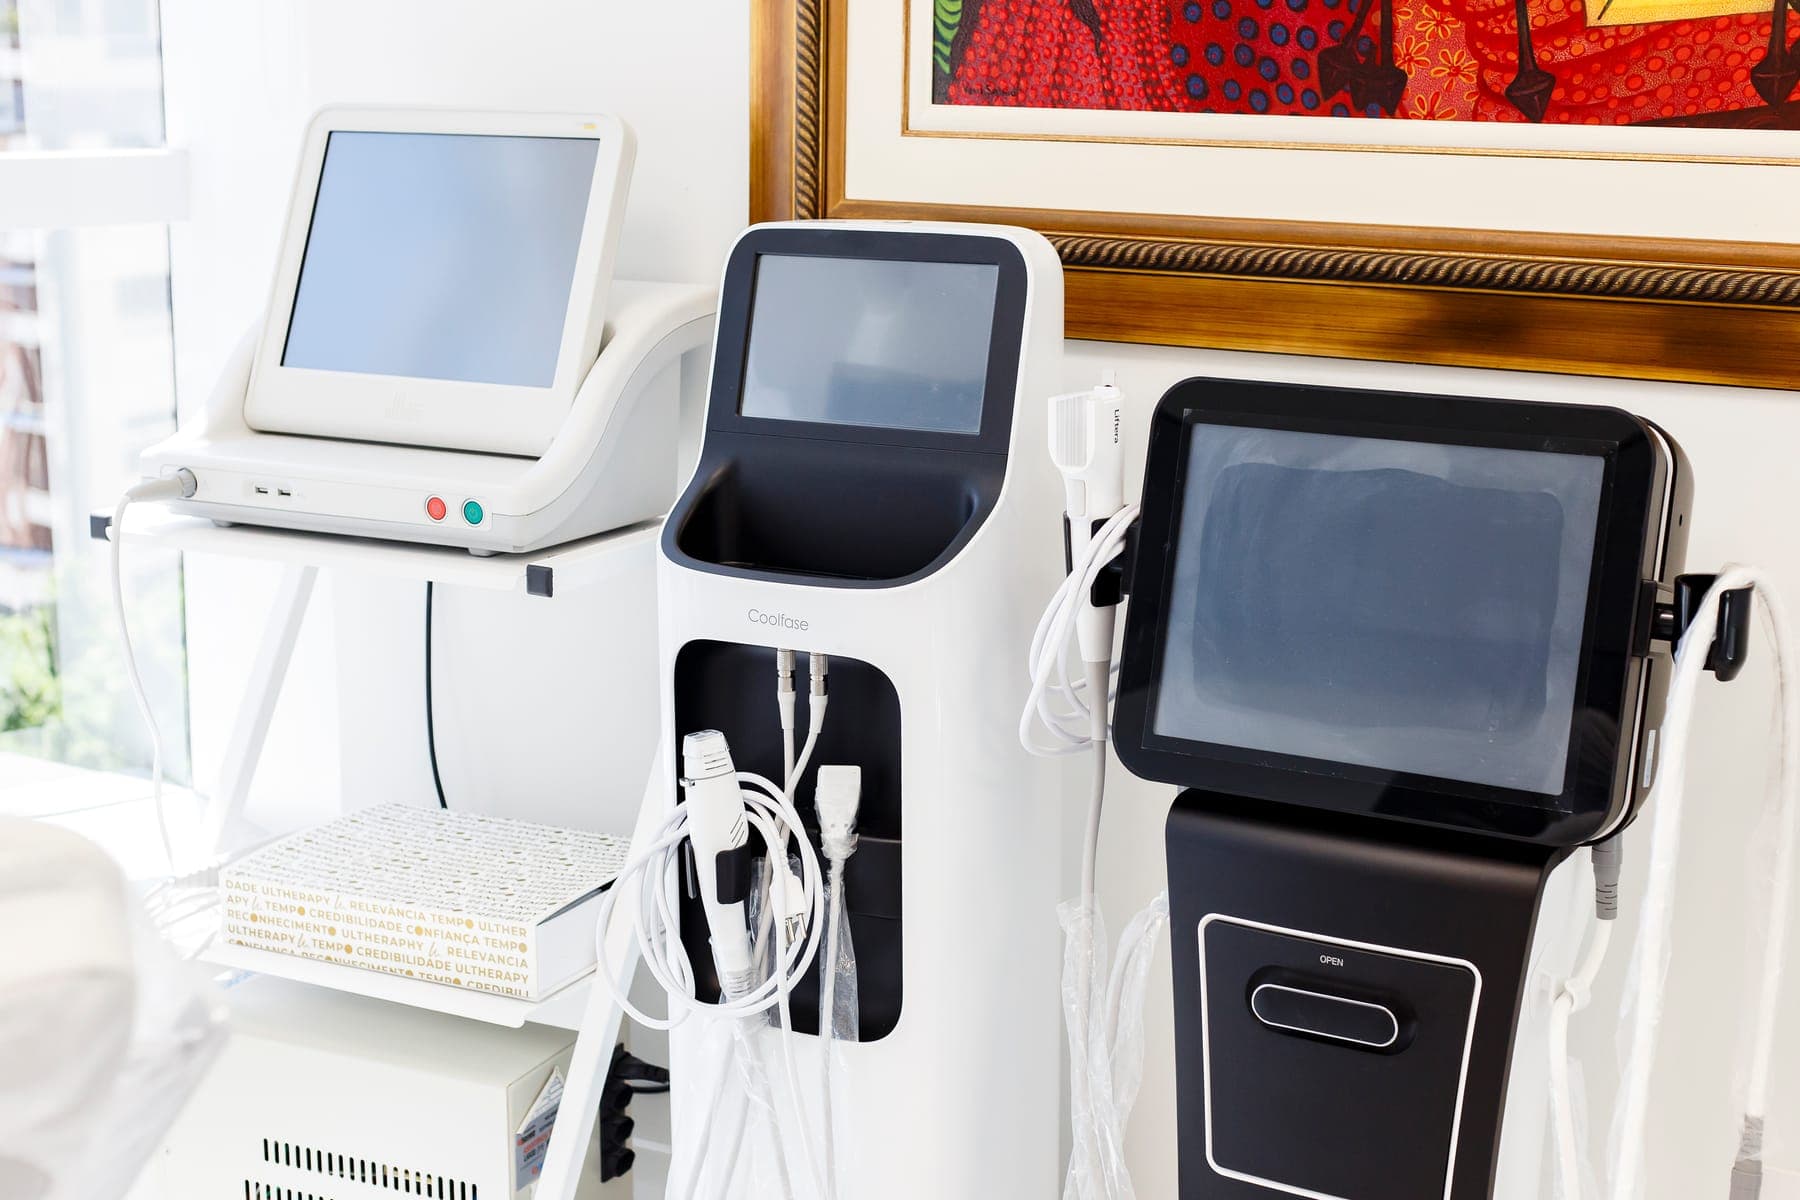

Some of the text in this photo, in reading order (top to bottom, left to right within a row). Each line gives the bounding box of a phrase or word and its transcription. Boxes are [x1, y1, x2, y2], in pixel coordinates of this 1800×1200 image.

[747, 608, 809, 631] Coolfase
[225, 879, 257, 894] DADE
[262, 886, 330, 905] ULTHERAPY
[430, 913, 474, 929] TEMPO
[479, 921, 527, 937] ULTHER
[227, 895, 249, 907] APY
[265, 901, 306, 916] TEMPO
[309, 908, 402, 933] CREDIBILIDADE
[406, 925, 480, 946] CONFIANÇA
[484, 937, 528, 953] TEMPO
[227, 909, 337, 936] RECONHECIMENTO
[342, 929, 424, 950] ULTHERAPHY
[227, 924, 296, 944] ULTHERAPY
[312, 938, 353, 954] TEMPO
[357, 946, 451, 971] CREDIBILIDADE
[455, 964, 529, 984] ULTHERAPY
[1320, 954, 1344, 967] OPEN
